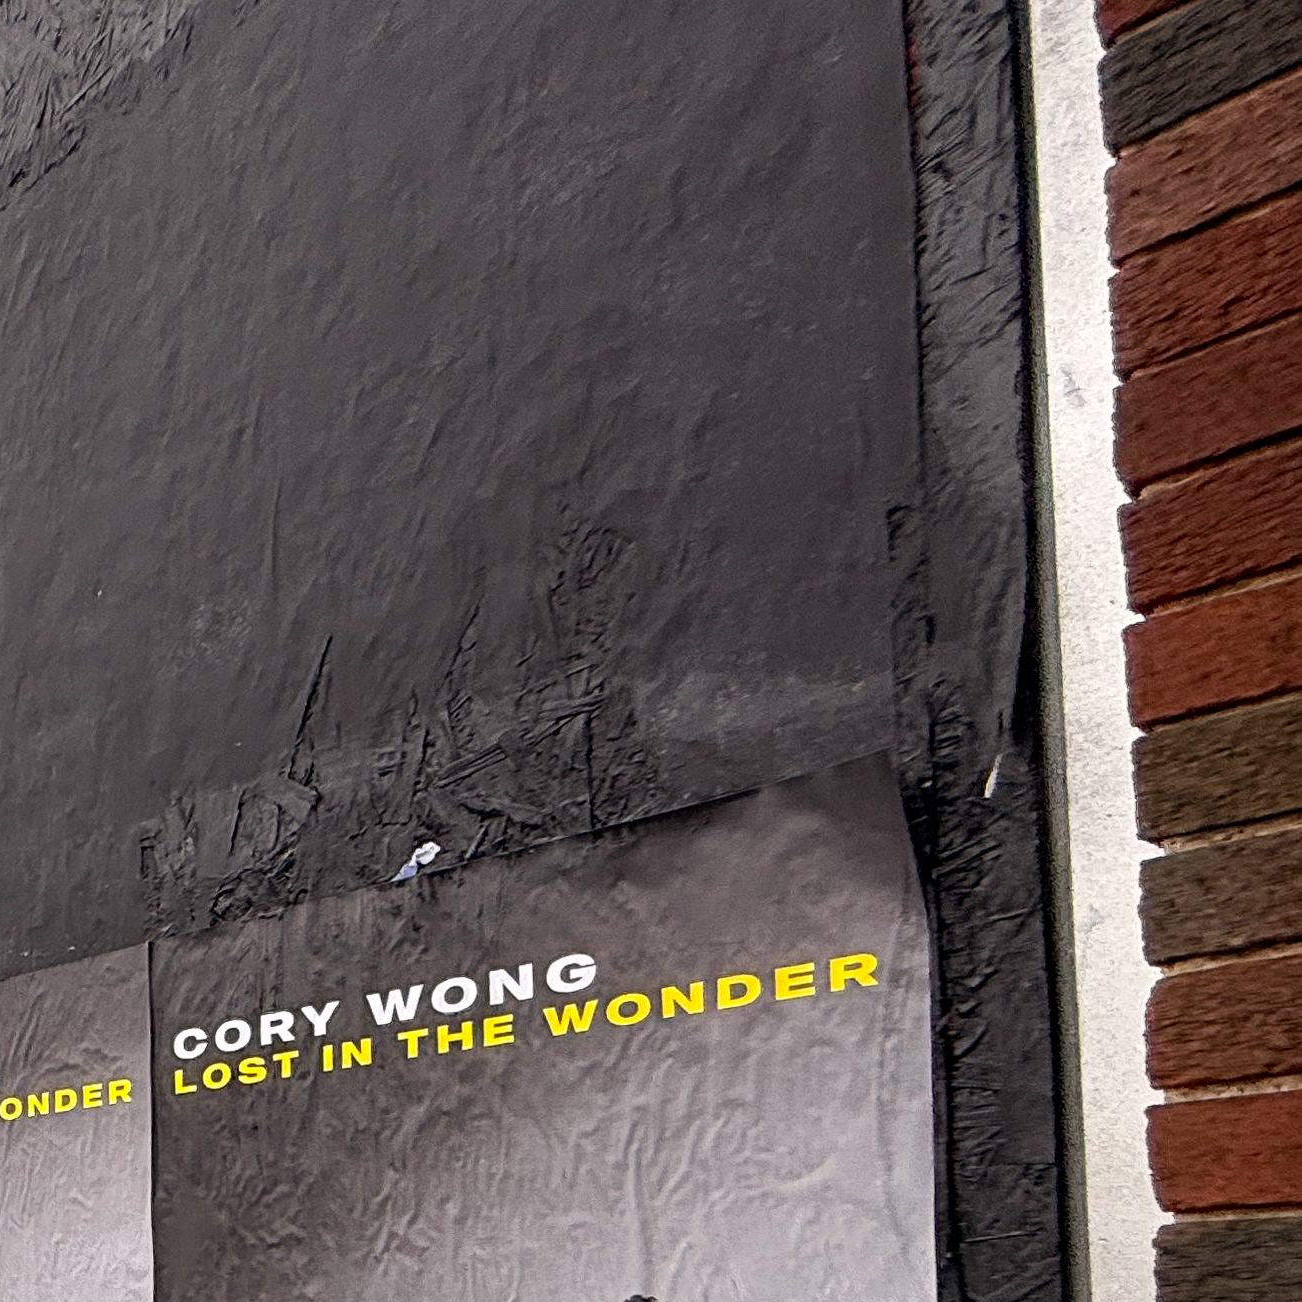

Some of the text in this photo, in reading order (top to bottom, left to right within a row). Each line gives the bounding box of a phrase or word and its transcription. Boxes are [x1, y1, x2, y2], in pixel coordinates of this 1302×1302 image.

[172, 953, 597, 1060] CORY WONG
[172, 952, 879, 1095] LOST IN THE WONDER
